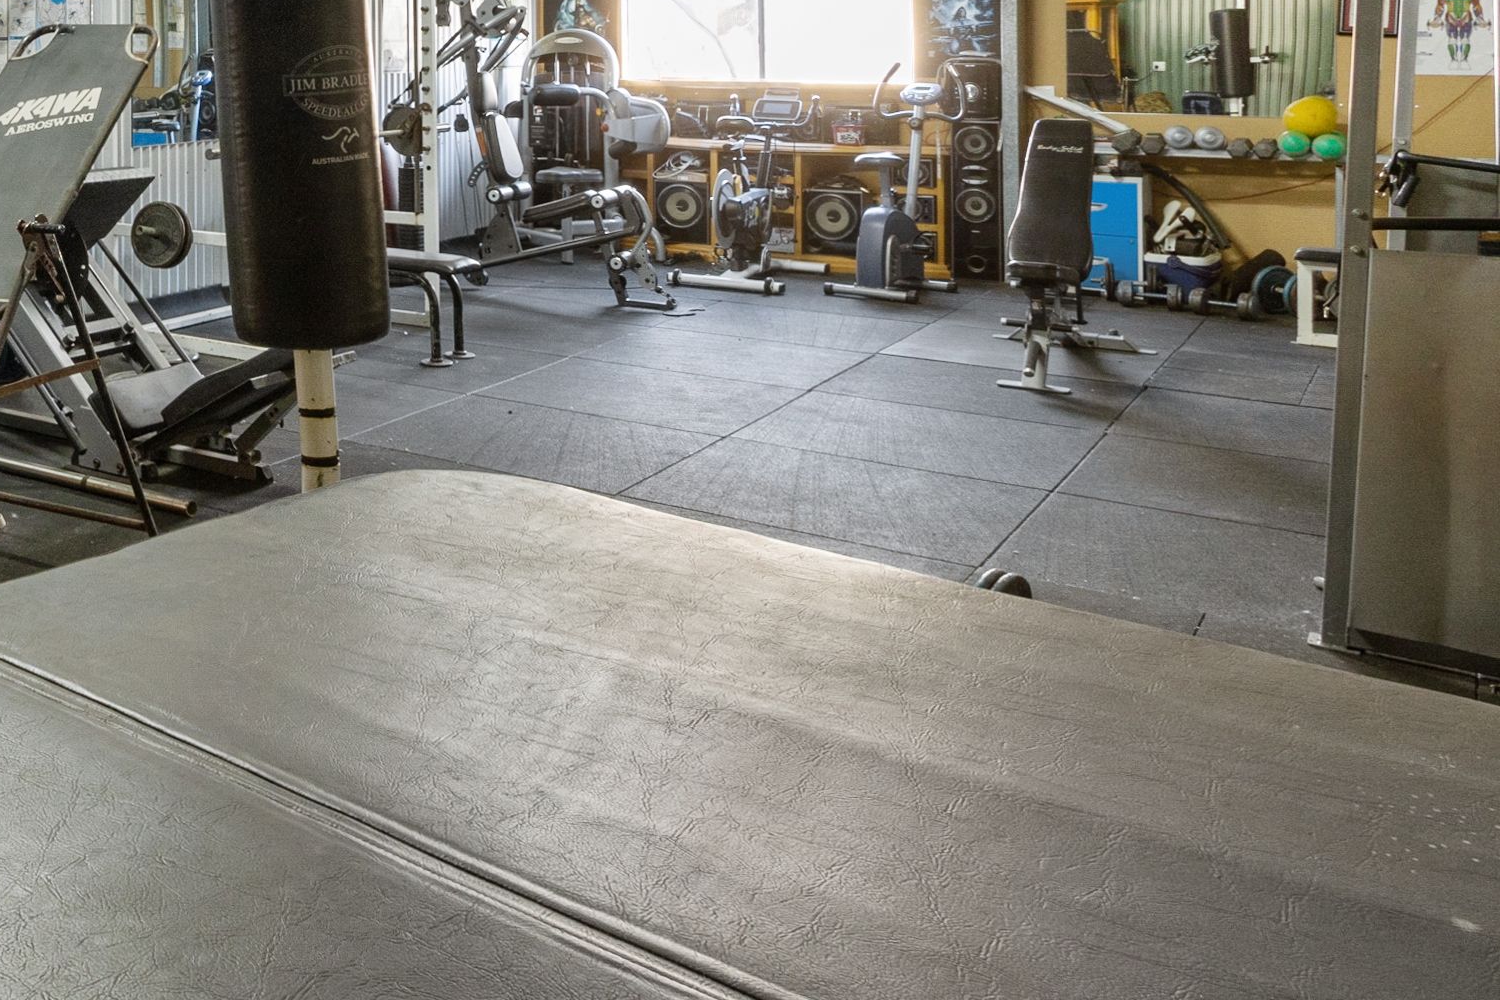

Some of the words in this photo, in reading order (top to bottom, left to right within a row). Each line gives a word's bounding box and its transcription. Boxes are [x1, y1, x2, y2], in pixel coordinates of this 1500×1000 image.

[289, 78, 316, 94] JIM
[322, 73, 369, 90] BRADLE
[4, 112, 94, 137] AEROSWING
[312, 153, 355, 165] AUSTRALIAN
